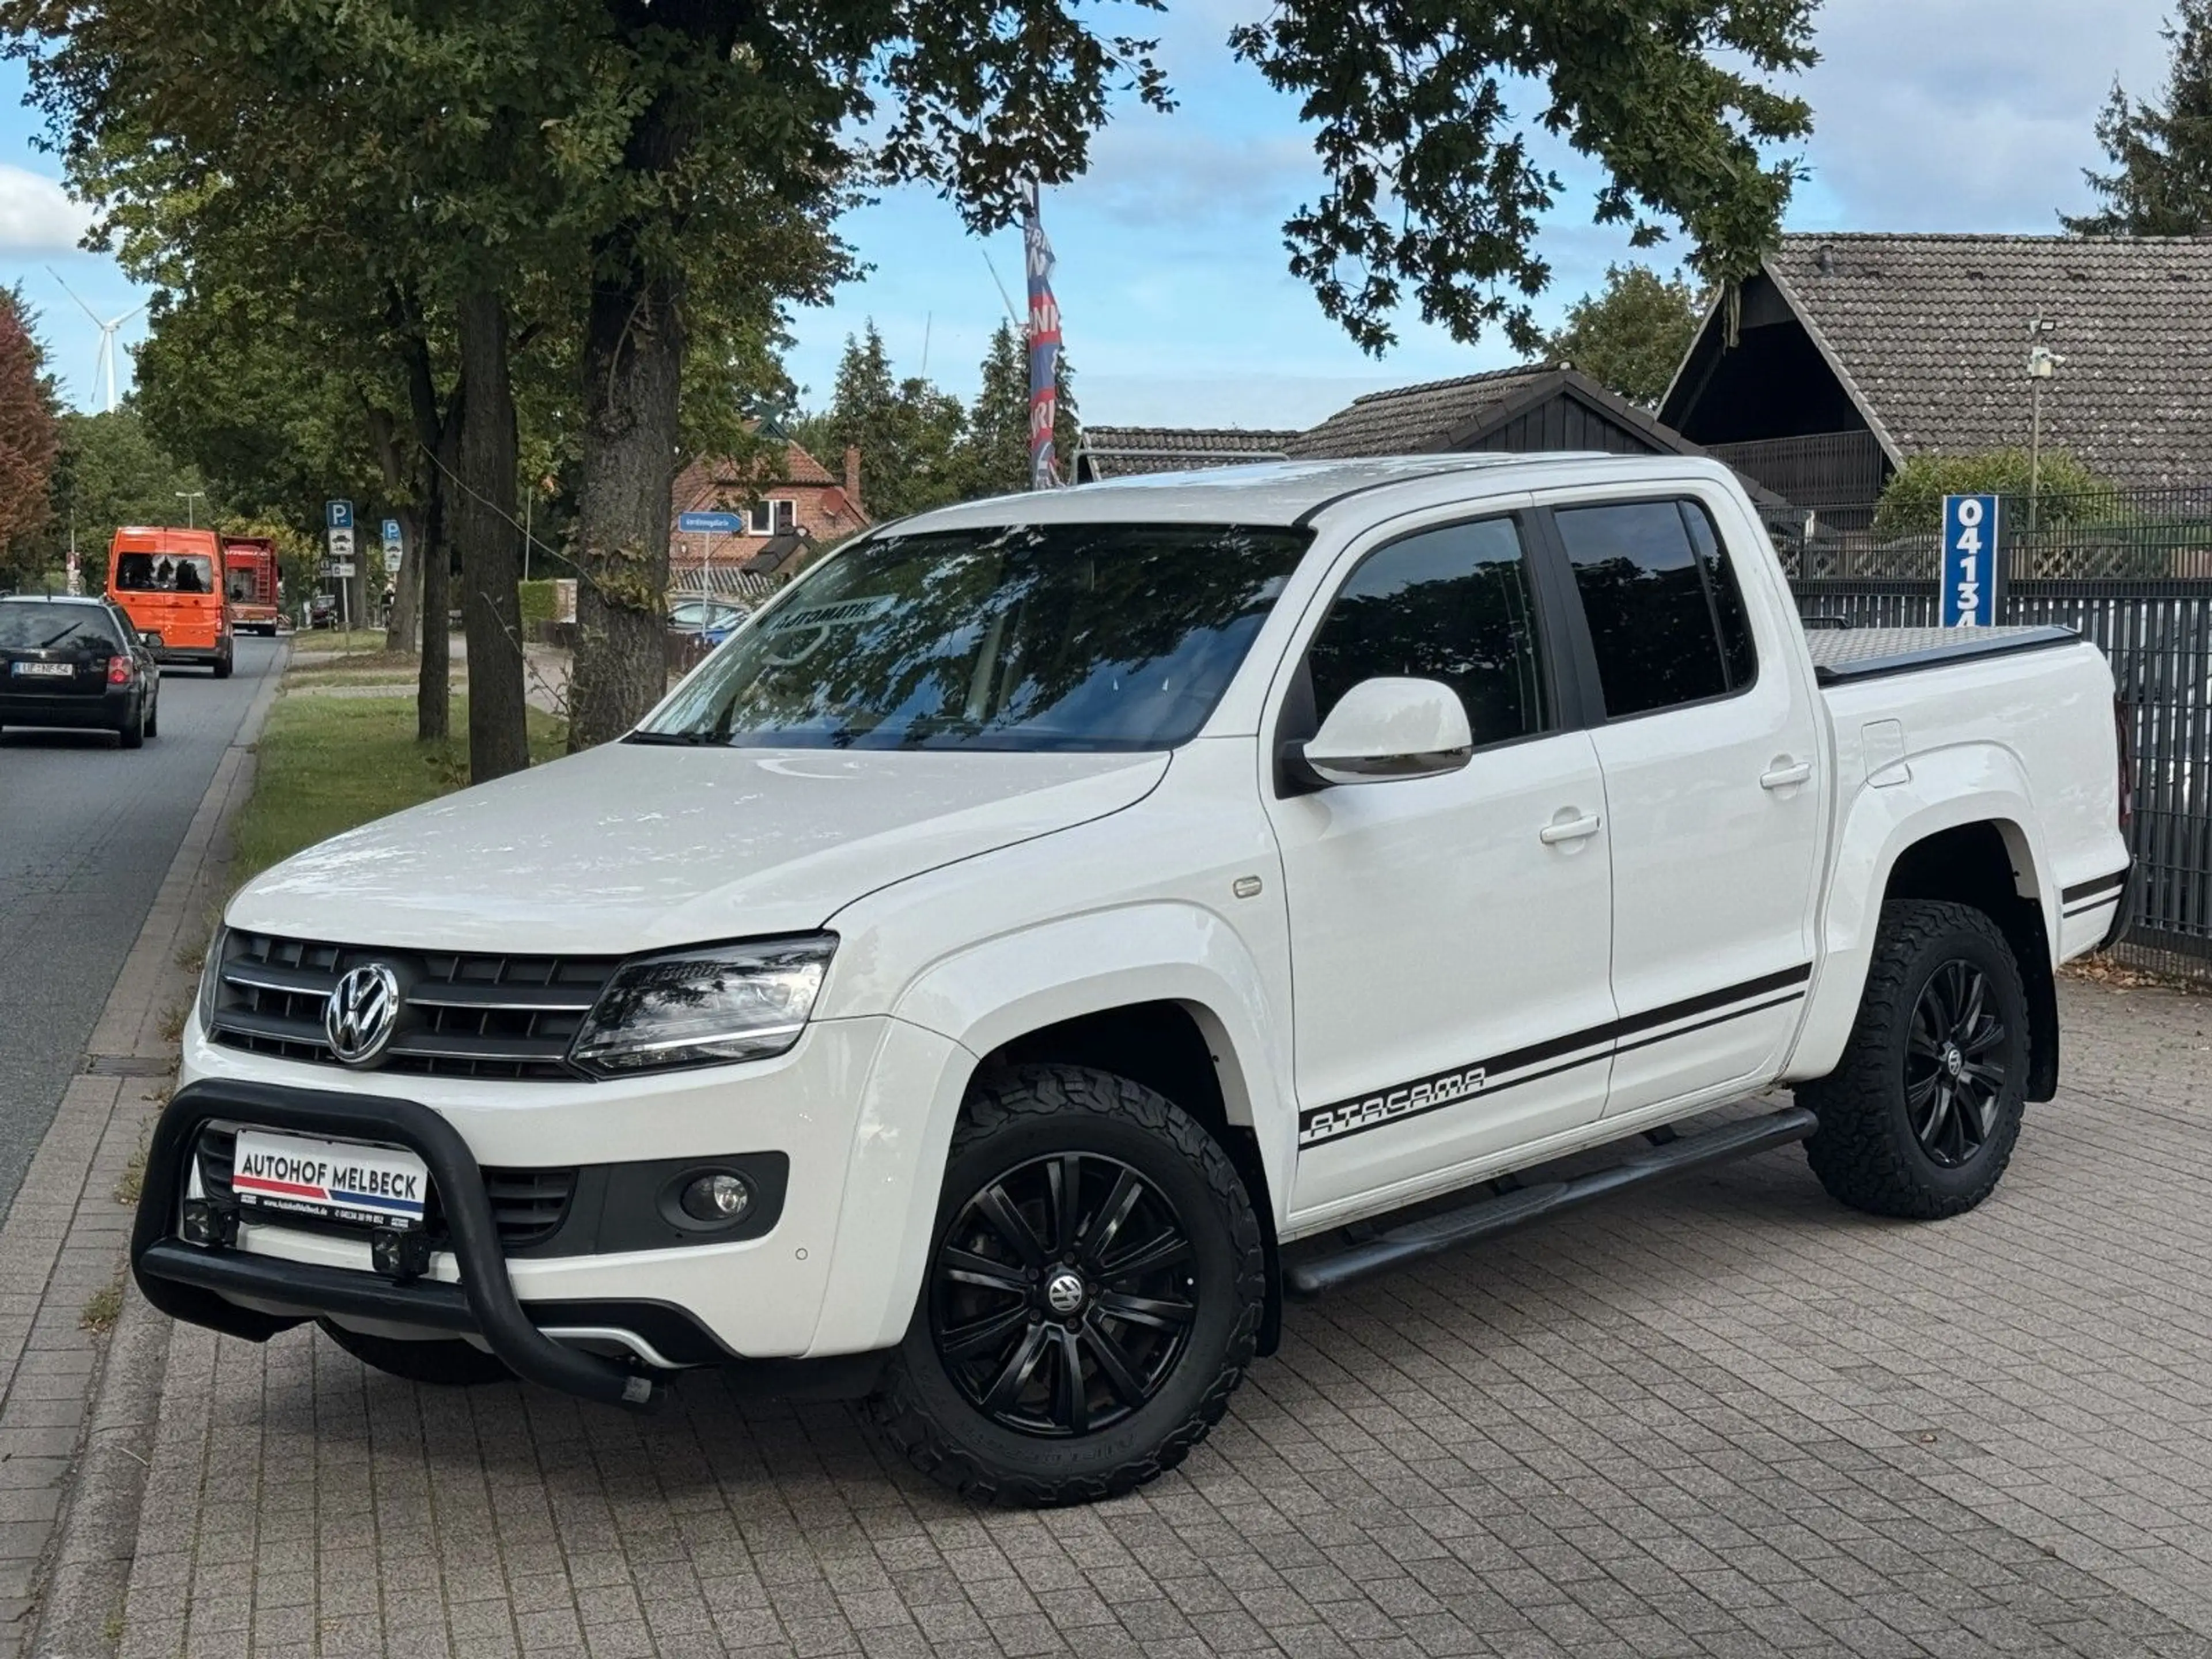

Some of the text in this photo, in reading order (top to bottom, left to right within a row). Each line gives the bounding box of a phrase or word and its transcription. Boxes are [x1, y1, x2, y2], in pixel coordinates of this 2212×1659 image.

[333, 505, 346, 525] P
[388, 523, 398, 539] P
[1956, 498, 1983, 627] 04134
[1310, 1067, 1486, 1137] ATACAMA
[242, 1153, 416, 1199] AUTOHOF MELBECK
